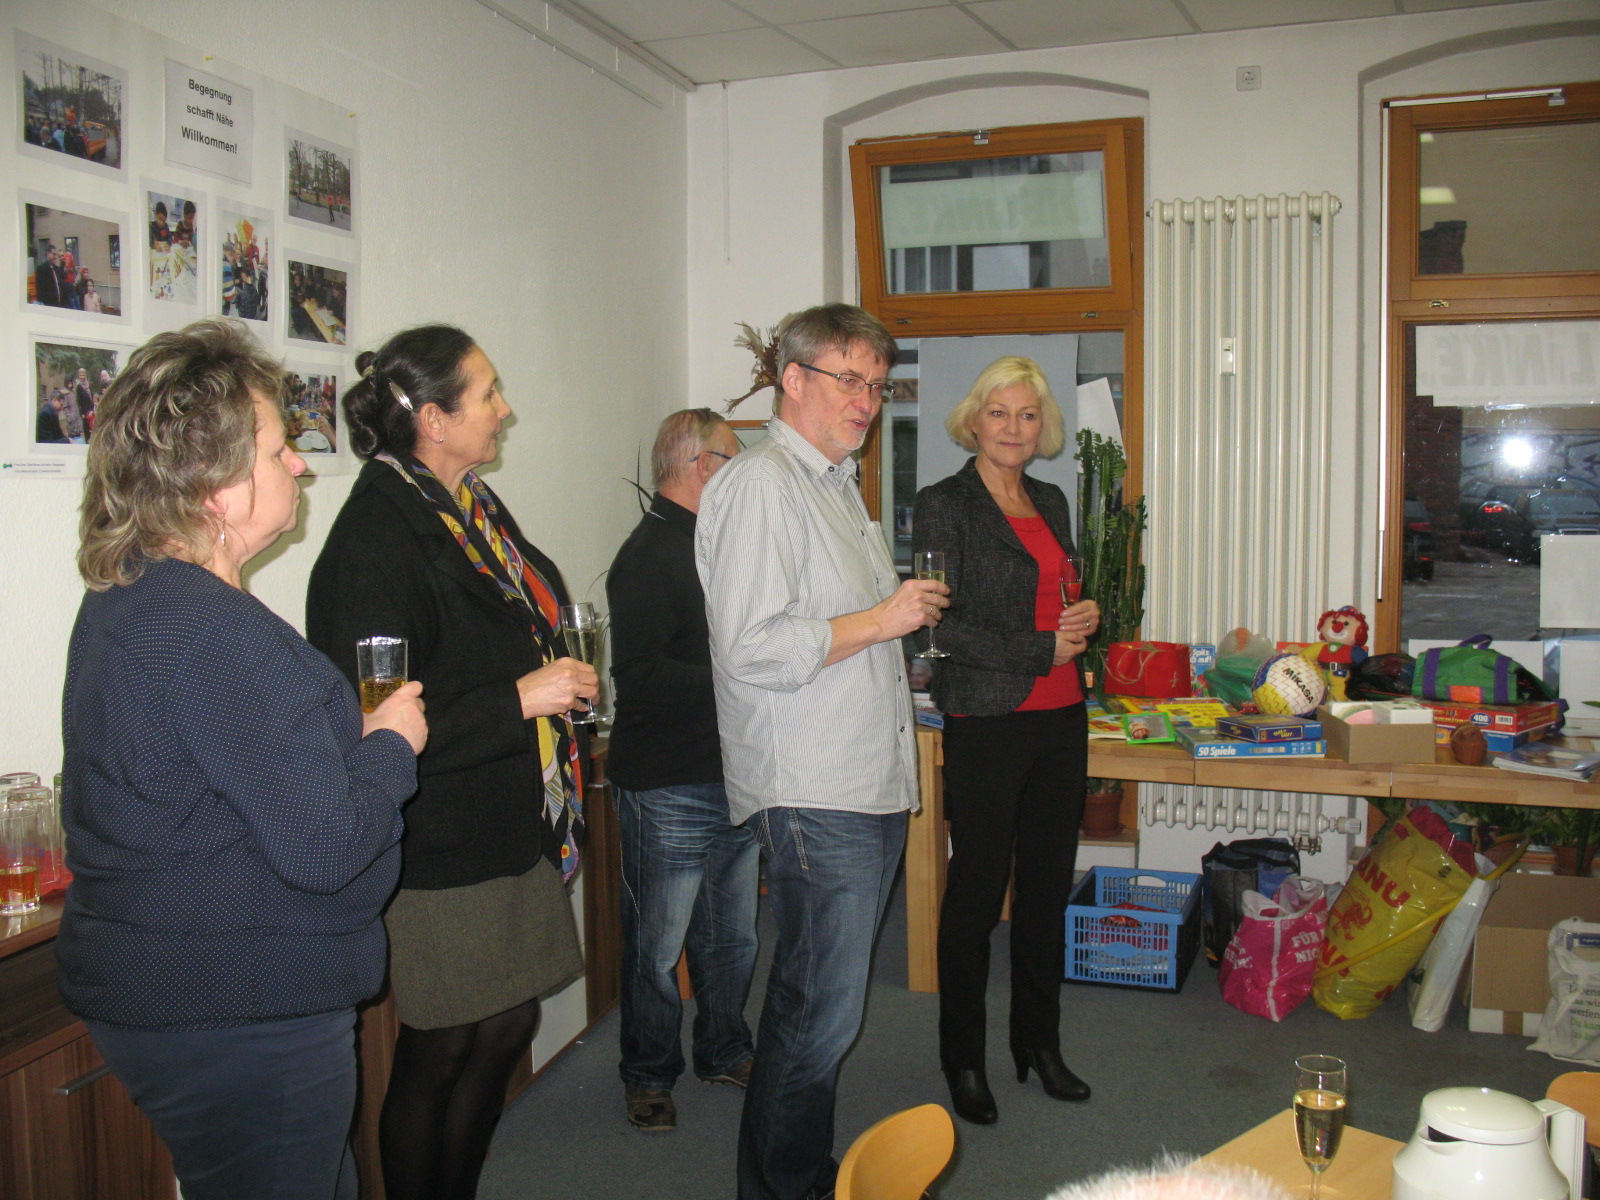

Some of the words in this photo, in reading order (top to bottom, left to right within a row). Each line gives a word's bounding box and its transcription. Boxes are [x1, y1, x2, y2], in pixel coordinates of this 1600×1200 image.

[188, 79, 232, 105] Begegnung
[186, 104, 215, 121] schafft
[216, 112, 234, 127] Nähe
[181, 126, 238, 154] Willkommen!
[1283, 668, 1314, 704] MIKASA
[1473, 714, 1489, 722] 400
[1197, 746, 1209, 756] 50
[1209, 745, 1237, 757] Spiele
[1291, 931, 1319, 947] FÜR
